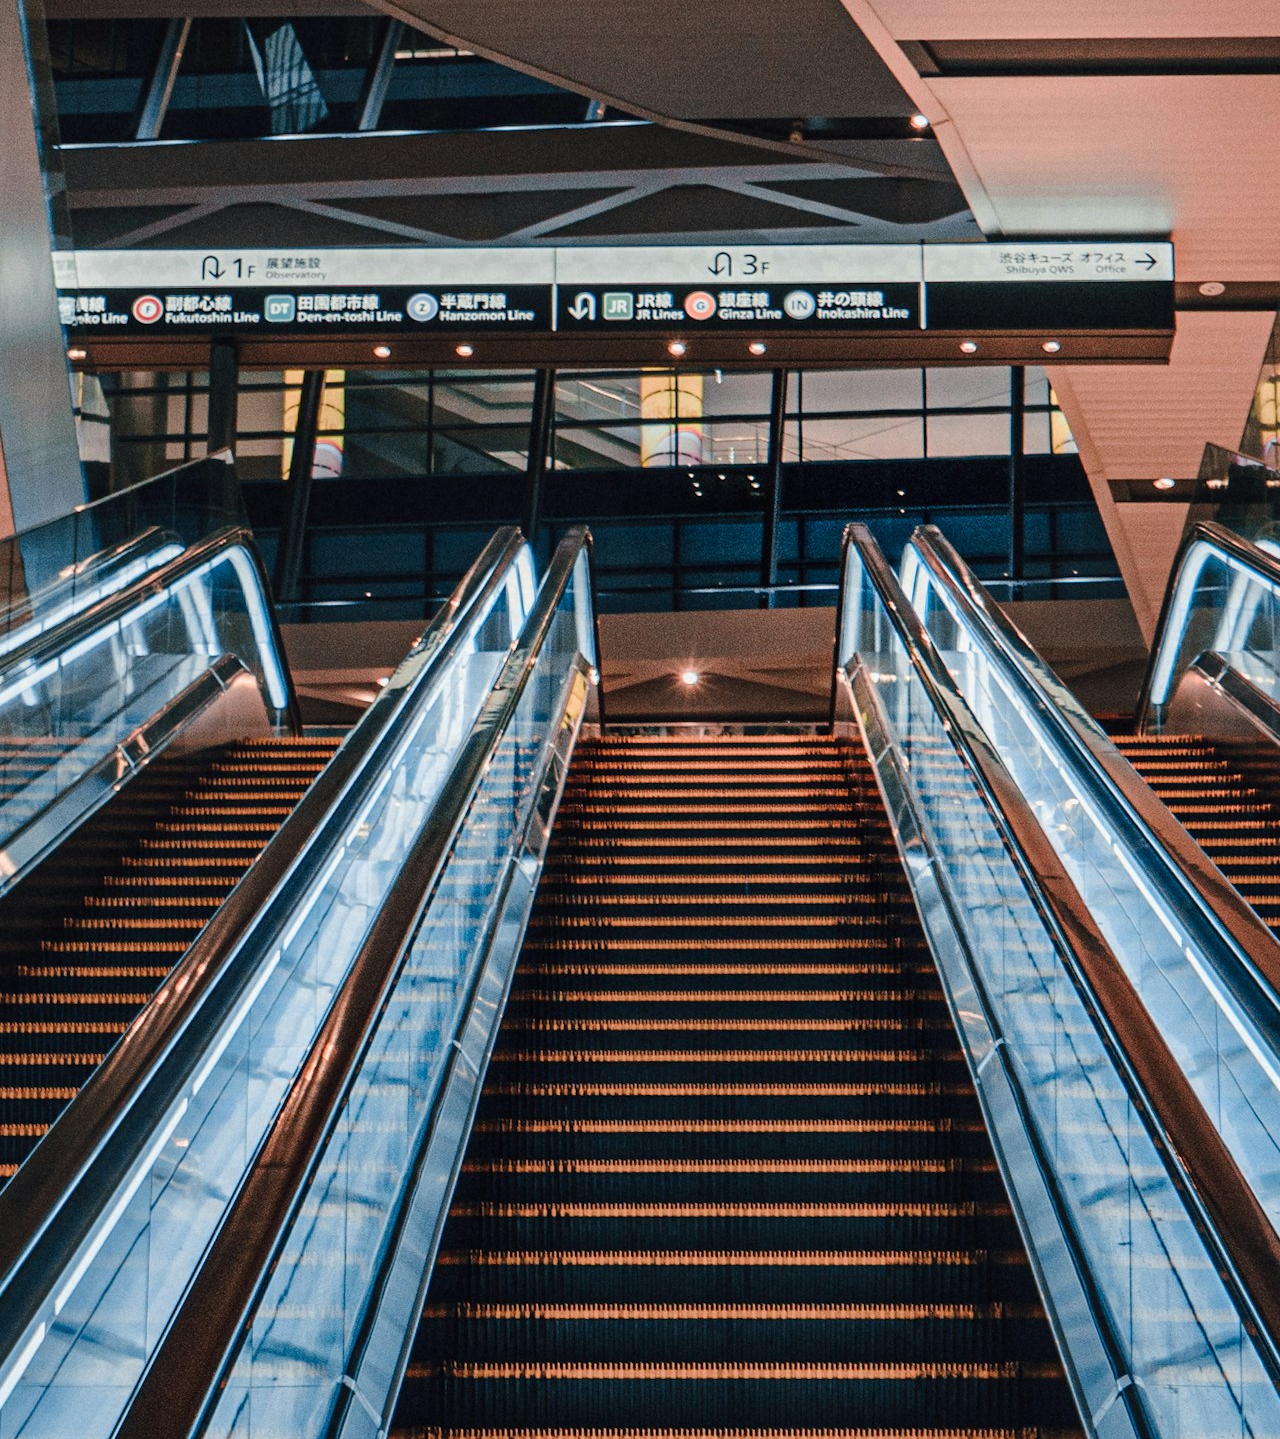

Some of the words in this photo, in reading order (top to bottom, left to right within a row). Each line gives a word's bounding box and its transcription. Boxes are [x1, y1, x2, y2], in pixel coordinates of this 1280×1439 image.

[266, 257, 321, 269] 展望施設
[999, 252, 1073, 264] 渋谷キューズ
[1080, 252, 1126, 263] オフィス
[265, 270, 327, 280] Observatory
[1005, 264, 1047, 275] Shibuya
[1049, 265, 1075, 274] QWS
[1095, 264, 1127, 274] Office
[165, 295, 232, 312] 副都心線
[297, 294, 380, 311] 田園都市線
[440, 294, 507, 310] 半蔵門線
[636, 294, 672, 309] JR線
[718, 293, 770, 309] 銀座線
[790, 299, 808, 311] IN
[817, 292, 883, 308] 井の頭線
[270, 302, 290, 314] DT
[607, 300, 628, 313] JR
[102, 312, 129, 324] Line
[165, 311, 232, 323] Fukutoshin
[234, 311, 261, 323] Line
[297, 311, 374, 322] Den-en-toshi
[376, 311, 402, 322] Line
[439, 310, 506, 321] Hanzomon
[507, 310, 535, 321] Line
[636, 308, 651, 320] JR
[652, 308, 684, 320] Lines
[719, 308, 756, 320] Ginza
[757, 308, 782, 320] Line
[817, 307, 880, 319] Inokashira
[882, 307, 910, 319] Line
